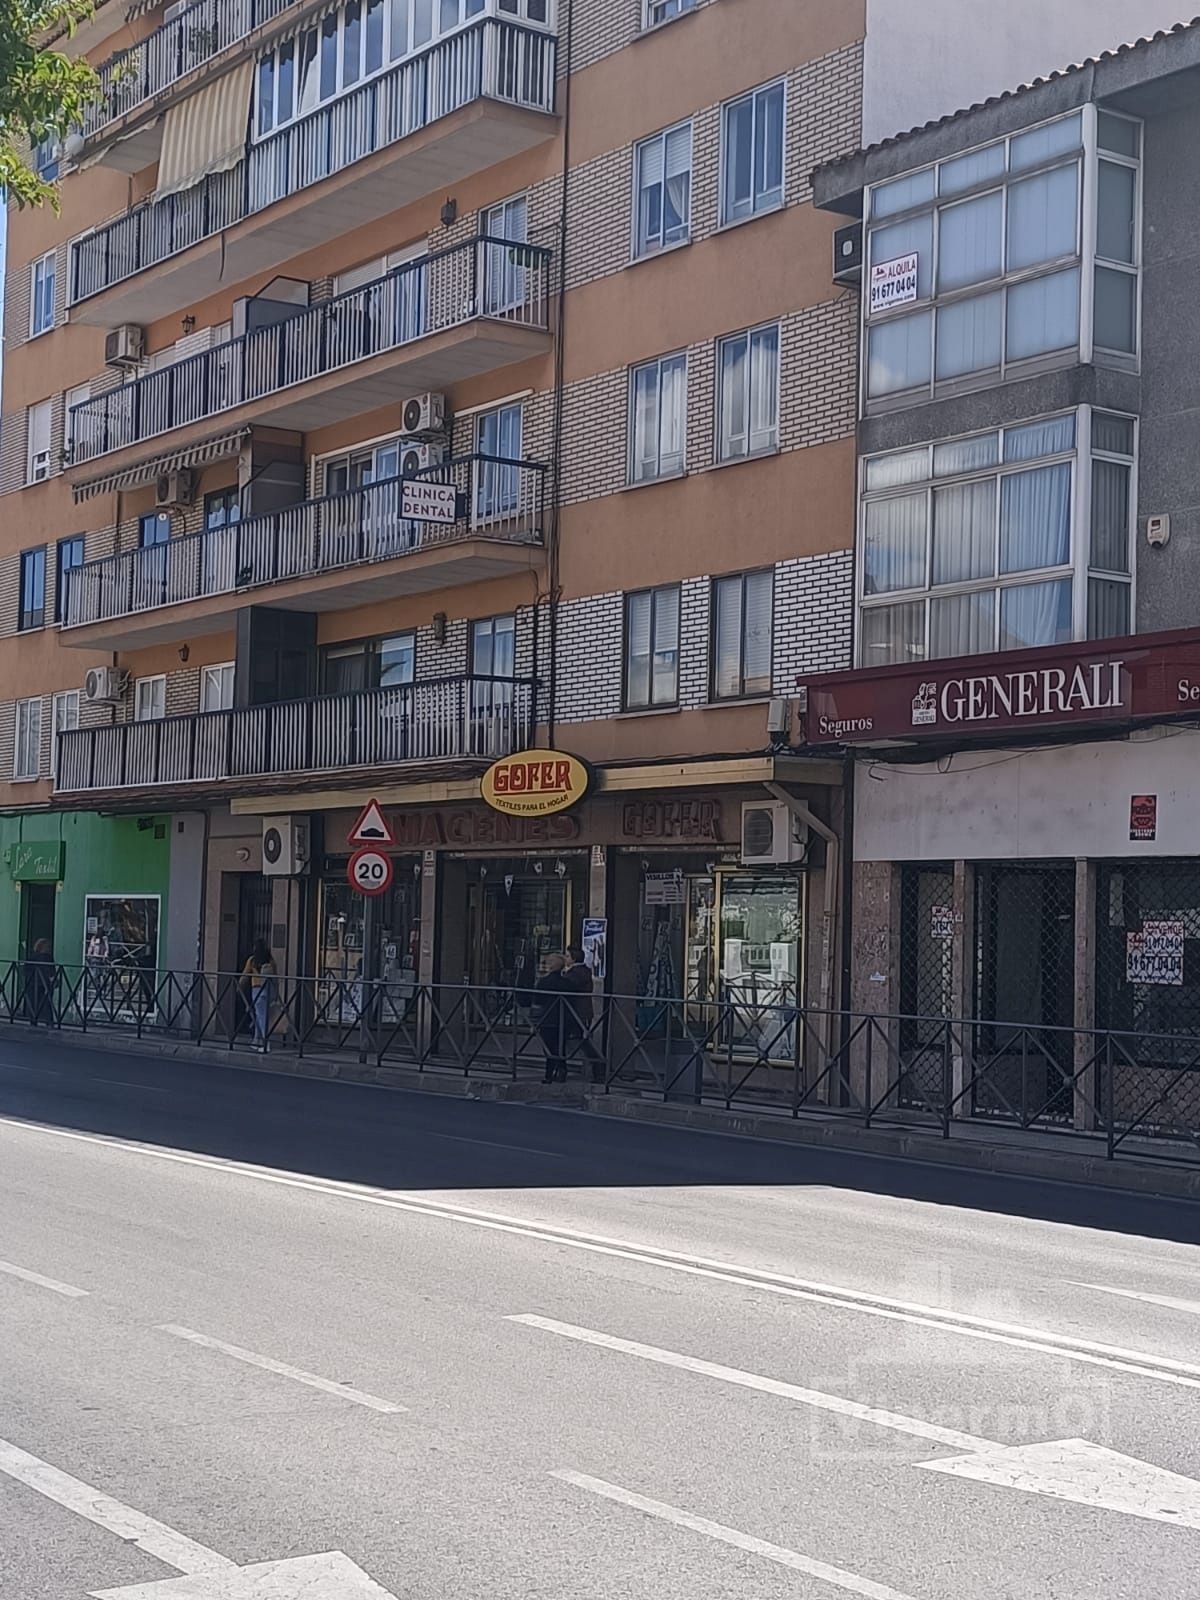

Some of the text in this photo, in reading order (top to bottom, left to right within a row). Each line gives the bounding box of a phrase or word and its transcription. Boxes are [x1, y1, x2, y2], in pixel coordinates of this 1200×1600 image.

[888, 259, 916, 278] ALQUILA
[402, 486, 455, 503] CLINICA
[404, 503, 453, 518] DENTAL
[941, 661, 1125, 722] GENERALI
[819, 715, 873, 738] Seguros
[493, 760, 573, 792] GOFER
[495, 794, 569, 811] TEXTILES PARA EL HOGAR
[358, 863, 384, 879] 20
